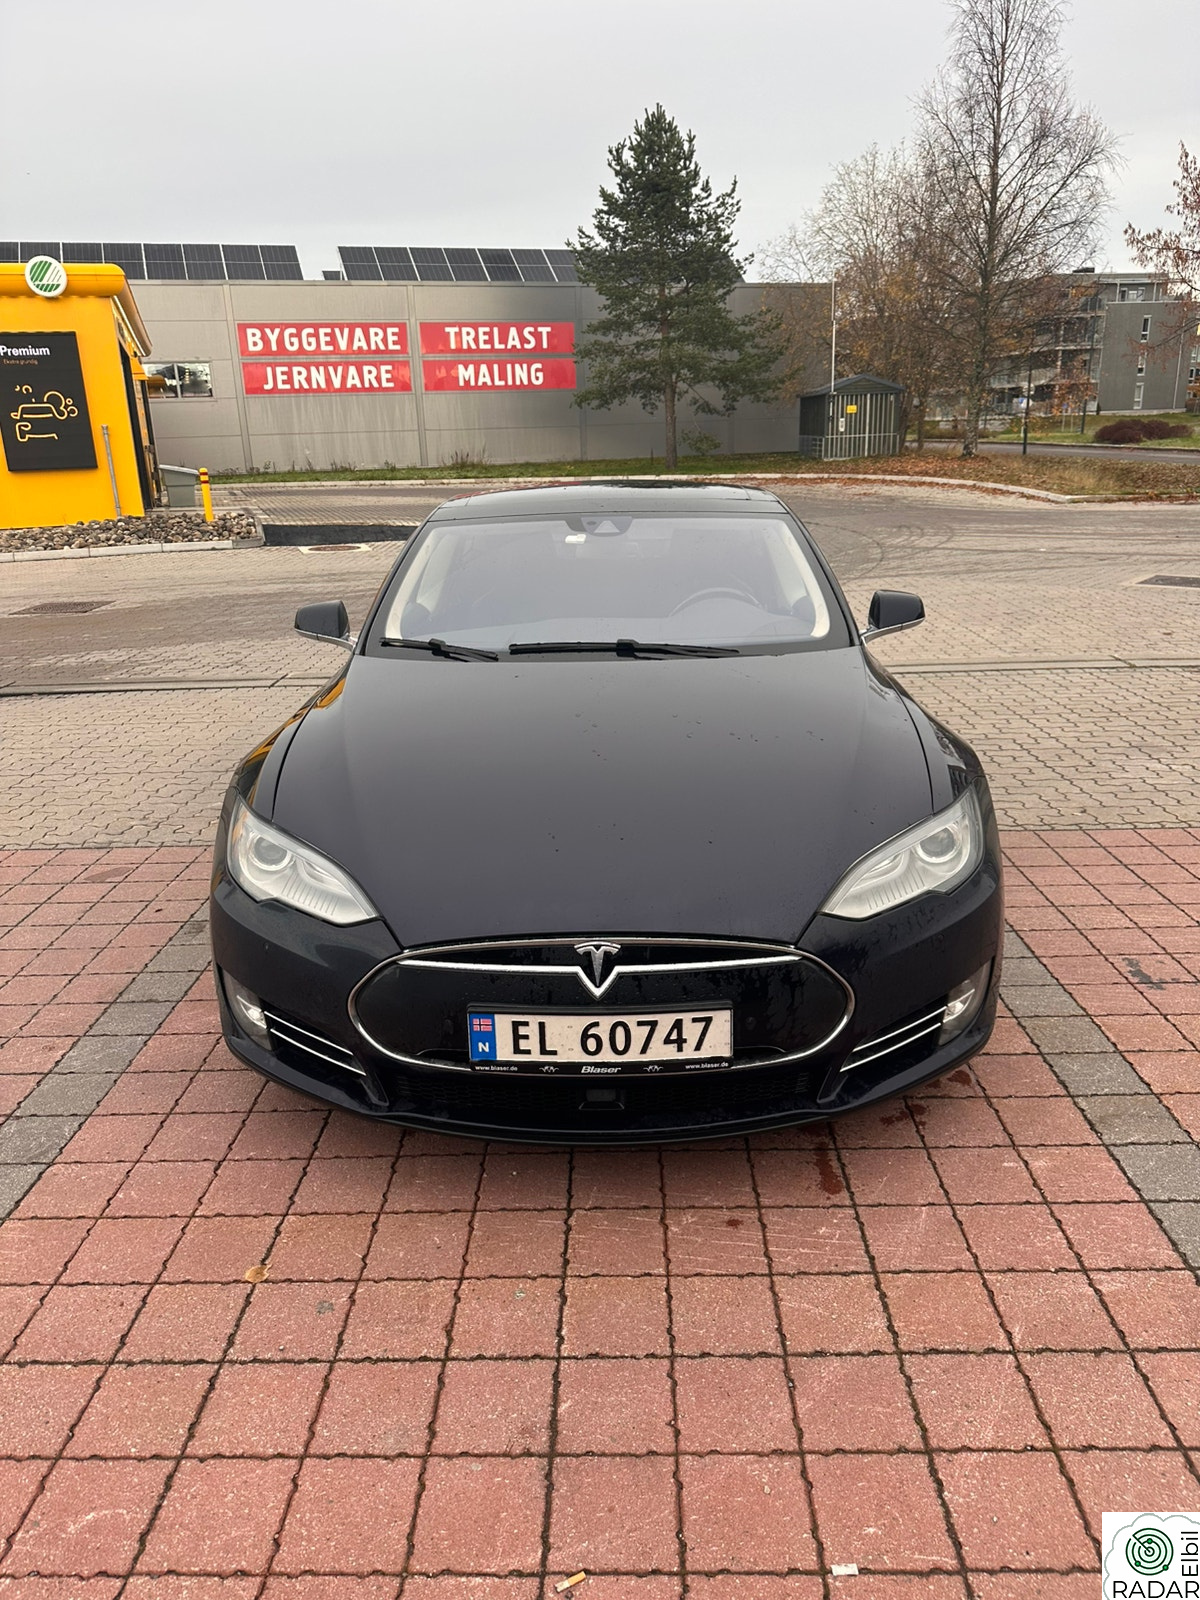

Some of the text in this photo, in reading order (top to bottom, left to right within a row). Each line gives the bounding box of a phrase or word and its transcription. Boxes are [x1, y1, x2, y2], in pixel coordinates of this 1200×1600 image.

[0, 344, 51, 356] Premium
[245, 326, 401, 352] BYGGEVARE
[444, 325, 552, 350] TRELAST
[263, 364, 395, 391] JERNVARE
[457, 362, 544, 387] MALING
[478, 1041, 490, 1052] N
[511, 1016, 713, 1057] EL 60747
[580, 1064, 622, 1074] Blaser
